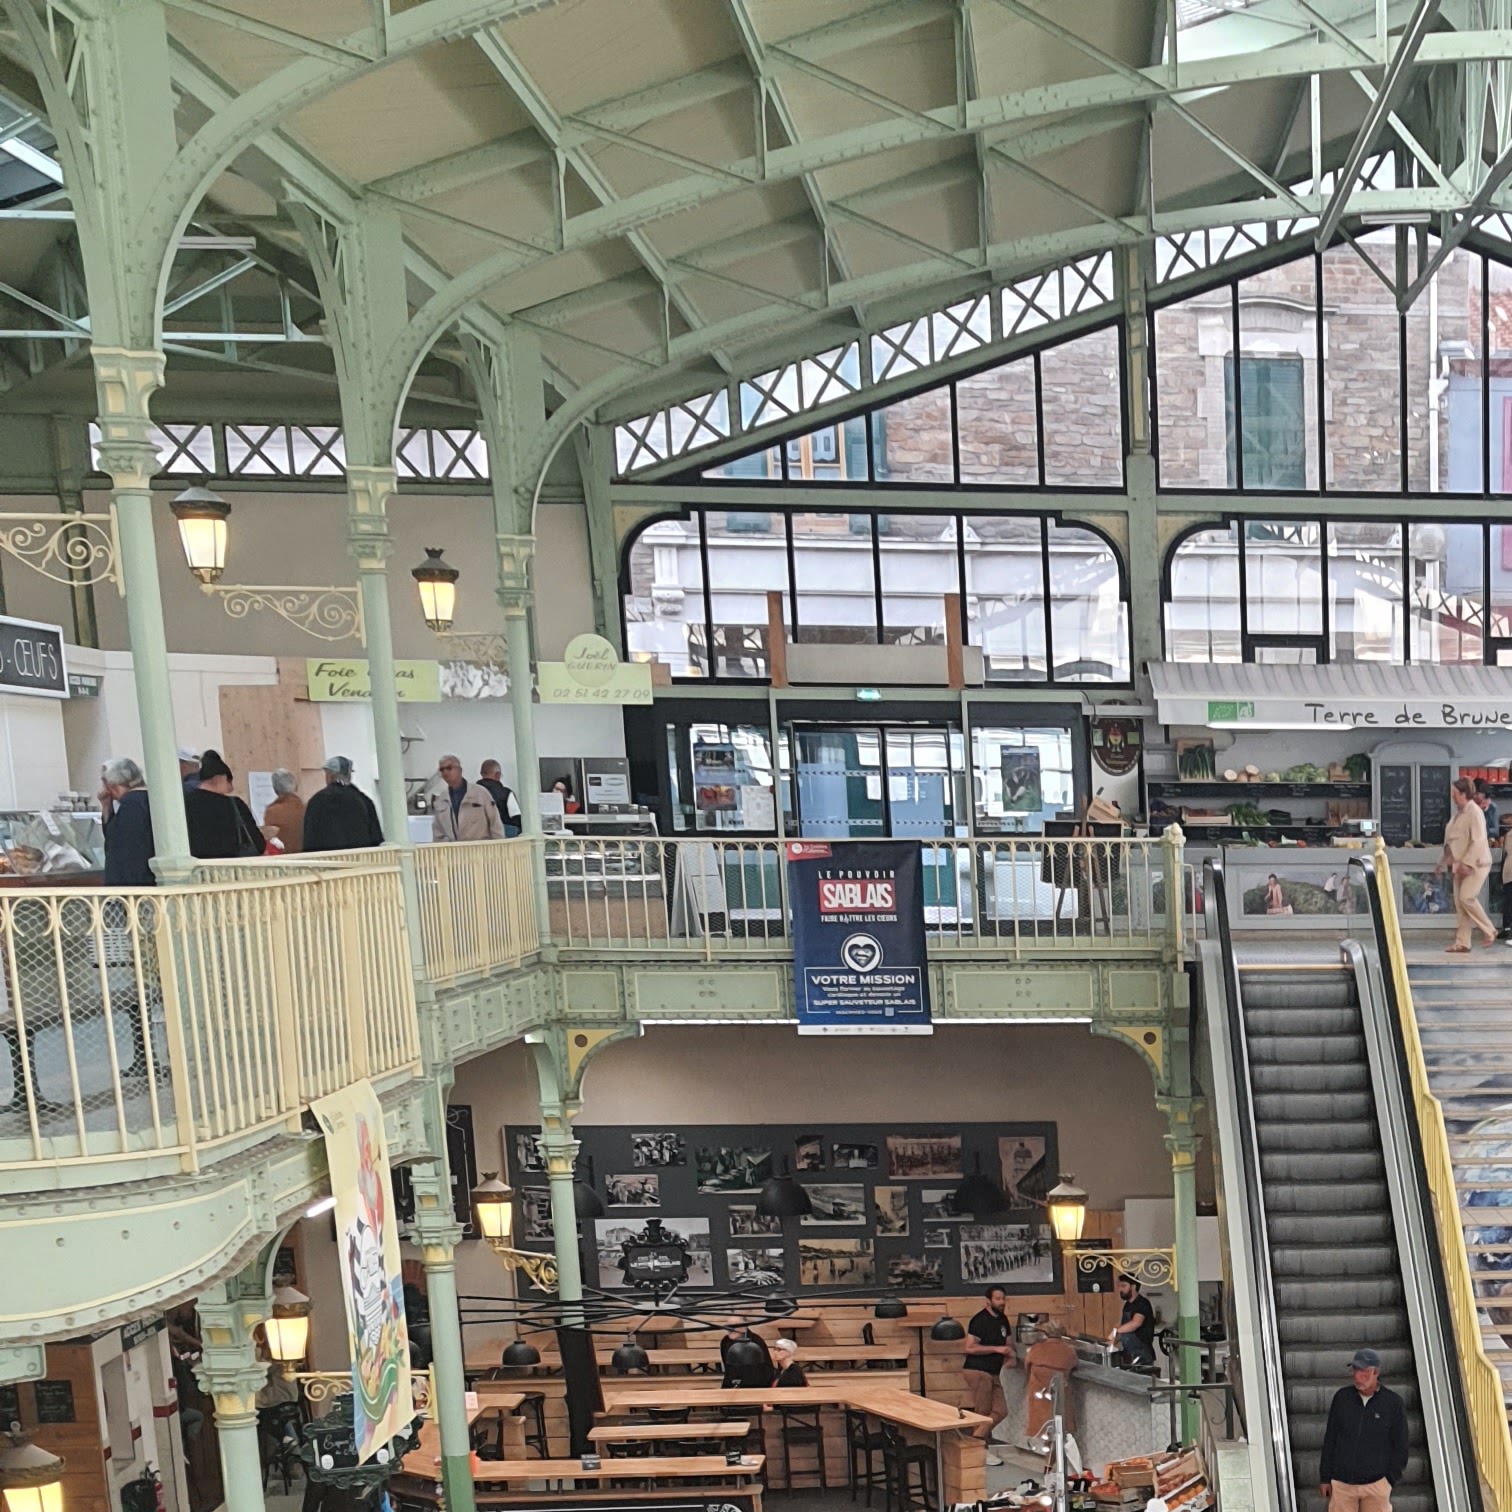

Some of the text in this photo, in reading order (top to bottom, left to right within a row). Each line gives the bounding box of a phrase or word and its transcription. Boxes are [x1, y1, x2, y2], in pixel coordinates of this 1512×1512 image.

[1304, 703, 1379, 725] Terre
[1394, 702, 1427, 725] de
[818, 870, 895, 879] LE POUVOIR
[823, 883, 893, 908] SABLAIS
[811, 974, 916, 985] VOTRE MISSION
